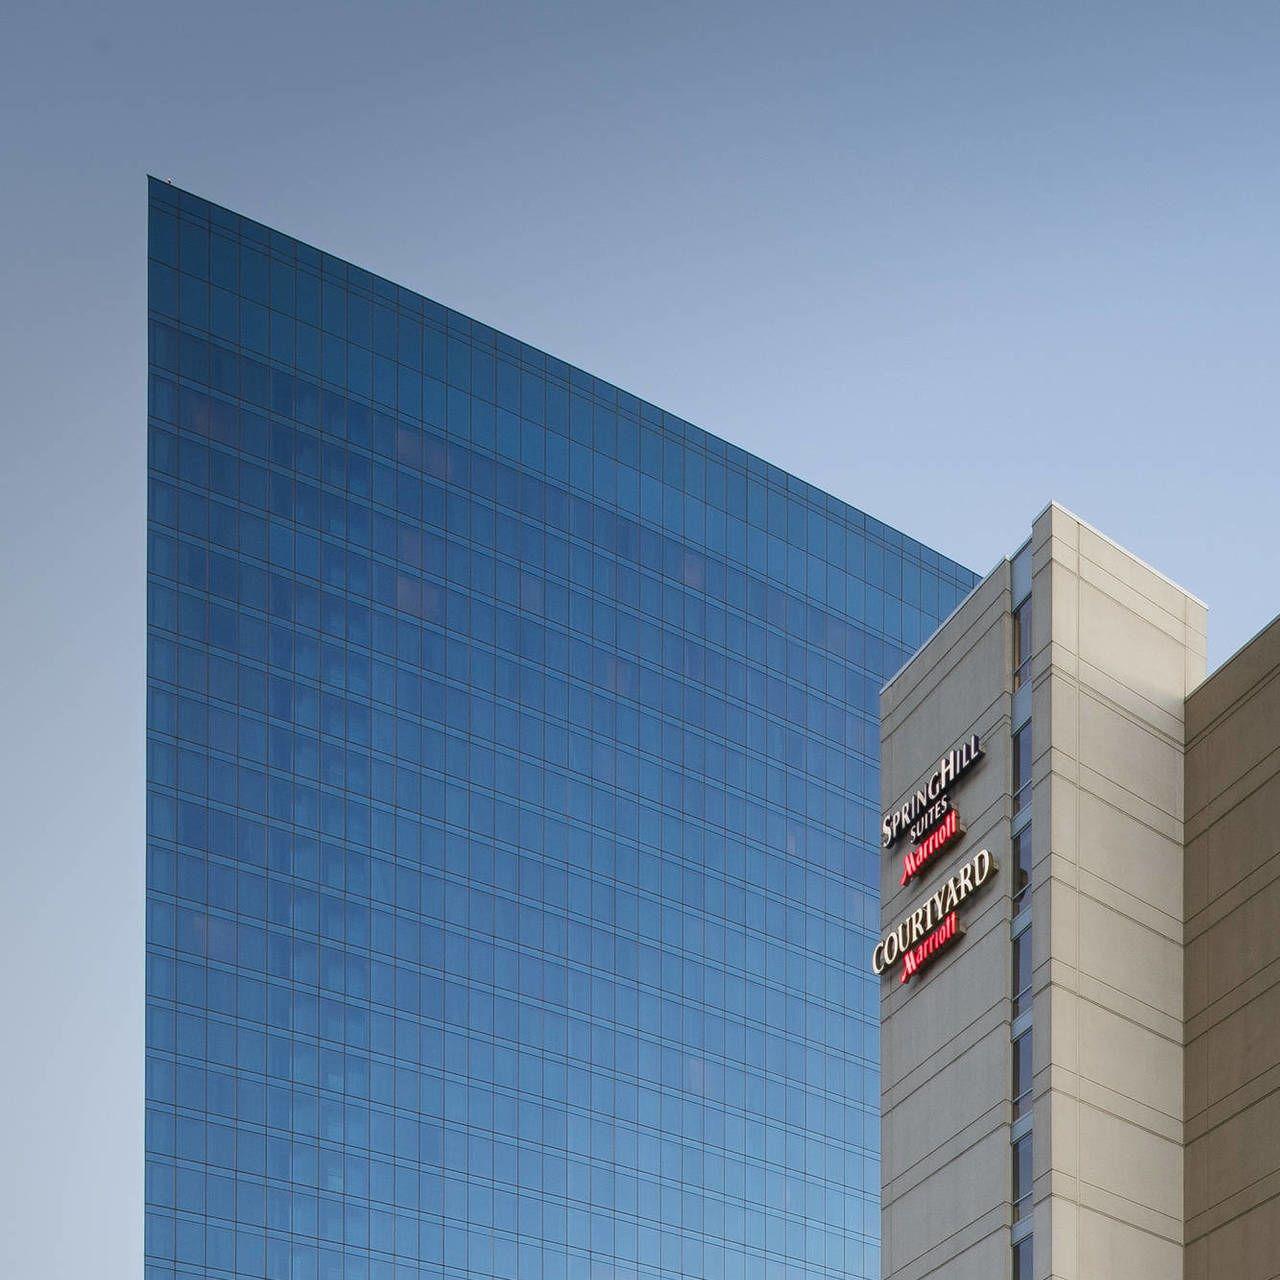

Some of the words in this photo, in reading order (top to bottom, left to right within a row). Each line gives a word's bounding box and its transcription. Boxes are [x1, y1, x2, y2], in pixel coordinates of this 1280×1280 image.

[882, 734, 981, 848] SPRINGHILL
[909, 794, 950, 844] SUITES
[899, 810, 958, 886] Marriott
[872, 848, 994, 975] COURTYARD
[899, 912, 958, 984] Marriott
